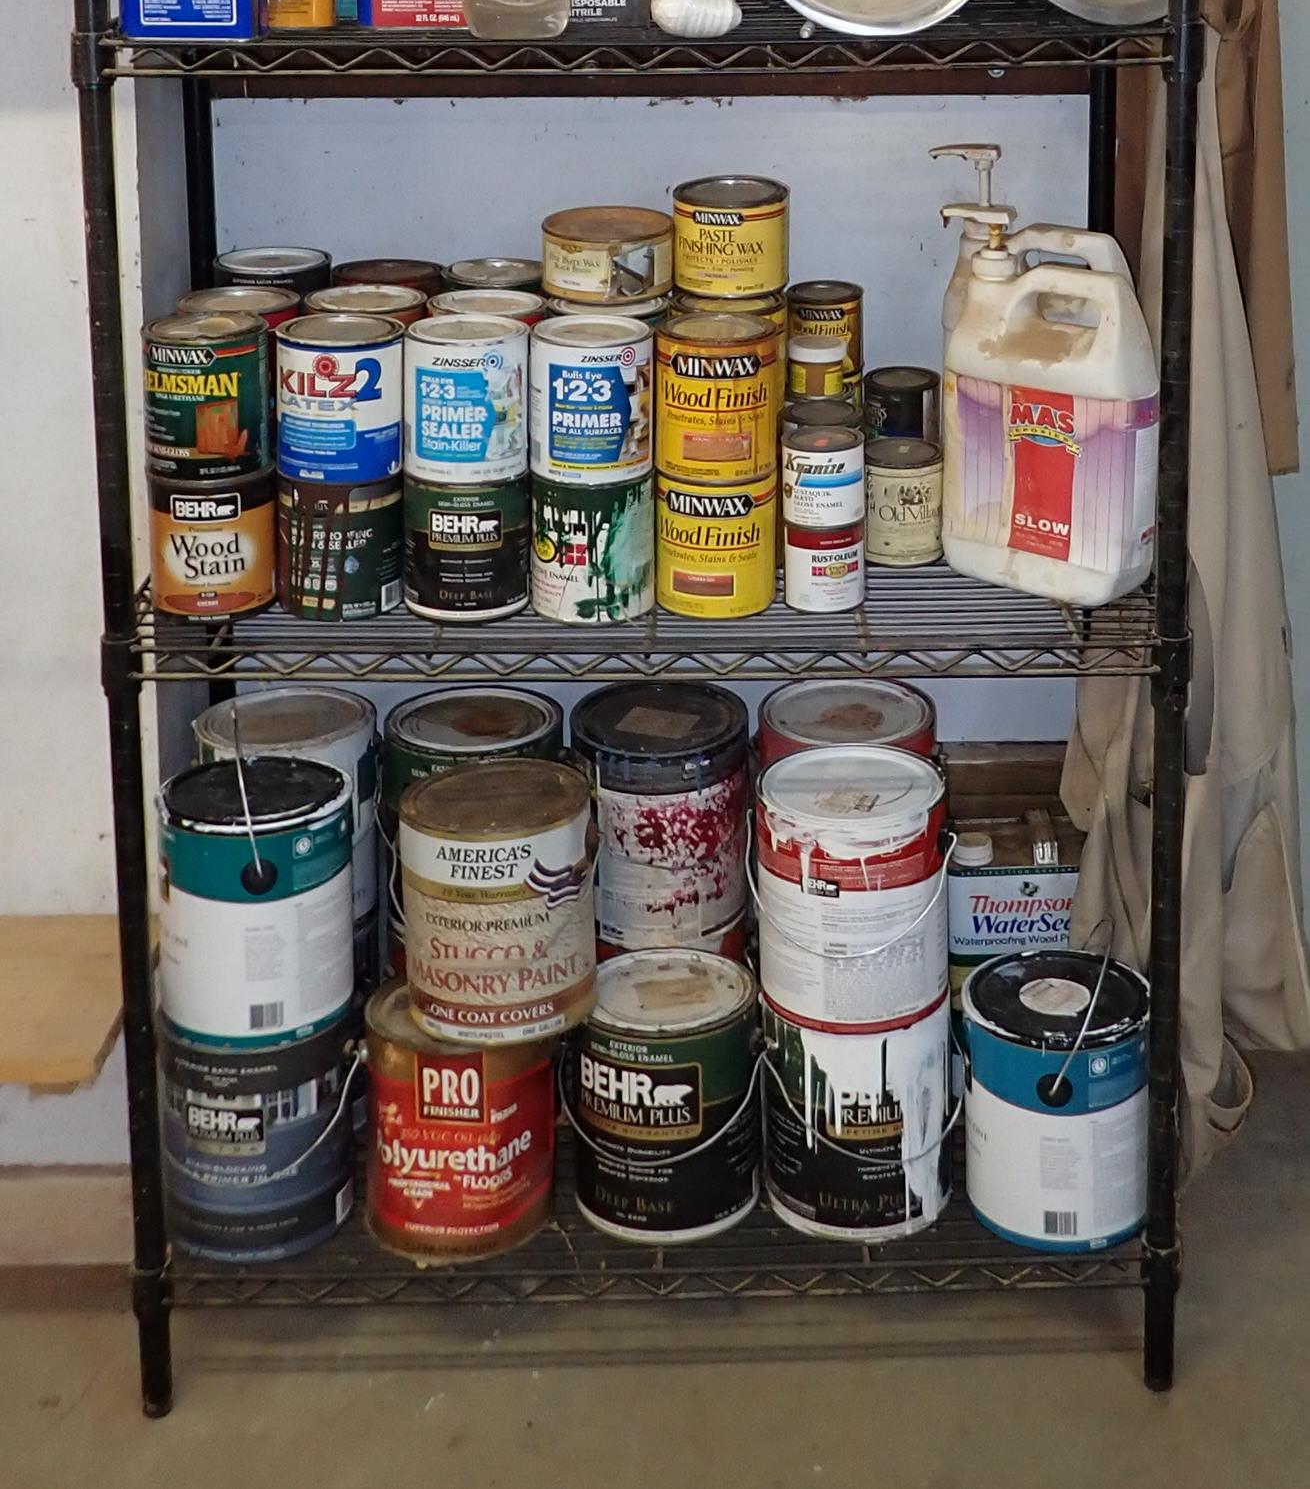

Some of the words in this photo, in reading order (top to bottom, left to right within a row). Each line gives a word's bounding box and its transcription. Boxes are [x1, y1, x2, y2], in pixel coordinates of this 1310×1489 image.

[570, 8, 603, 16] ITRILE
[695, 212, 740, 225] MINWAX
[700, 228, 736, 243] PASTE
[679, 235, 734, 256] FINISHING
[737, 240, 764, 254] WAX
[800, 310, 842, 320] MINWAX
[152, 347, 208, 364] MINWAX
[432, 357, 485, 367] ZINSSER
[581, 354, 622, 363] ZINSSER
[562, 370, 583, 380] Bulls
[585, 371, 602, 382] Eye
[677, 356, 755, 377] MINWAX
[145, 369, 238, 397] ELMSMAN
[280, 365, 357, 398] KILZ
[355, 357, 382, 402] 2
[281, 395, 359, 411] LATEX
[665, 380, 711, 407] Wood
[717, 382, 767, 408] Finish
[552, 411, 622, 428] PRIMER
[1010, 404, 1075, 435] MAS
[421, 421, 484, 439] SEALER
[552, 426, 566, 434] FOR
[584, 427, 622, 436] SURFACES
[422, 437, 482, 452] Stain-Killer
[175, 501, 217, 518] BEHR
[670, 492, 747, 516] MINWAX
[879, 505, 906, 522] Old
[431, 513, 479, 533] BEHR
[661, 515, 702, 545] Wood
[705, 522, 760, 546] Finish
[1014, 512, 1070, 536] SLOW
[170, 533, 240, 558] Wood
[431, 532, 474, 544] PREMIUM
[476, 533, 498, 543] PLUS
[699, 553, 726, 563] Stains
[740, 551, 758, 561] Seals
[184, 554, 245, 581] Stain
[436, 844, 532, 863] AMERICA'S
[450, 862, 518, 880] FINEST
[807, 879, 827, 892] EHR
[426, 911, 482, 932] EXTERIOR
[486, 911, 550, 932] PREMIUM
[953, 935, 1026, 947] Waterproofing
[1028, 934, 1058, 944] Wood
[413, 958, 514, 995] MASONRY
[518, 953, 578, 992] PAINT
[431, 1002, 455, 1020] ONE
[458, 1010, 495, 1023] COAT
[500, 1002, 554, 1022] COVERS
[609, 1040, 648, 1052] EXTERIOR
[637, 1054, 674, 1062] ENAMEL
[422, 1067, 480, 1106] PRO
[580, 1053, 653, 1107] BEHR
[423, 1106, 480, 1119] FINISHER
[580, 1088, 644, 1125] PREMIUM
[650, 1107, 691, 1125] PLUS
[842, 1105, 903, 1125] PREMIU
[188, 1105, 237, 1131] BEHR
[463, 1166, 513, 1189] FLOORS
[595, 1185, 629, 1208] DEEP
[636, 1197, 674, 1214] BASE
[818, 1191, 870, 1210] ULTRA
